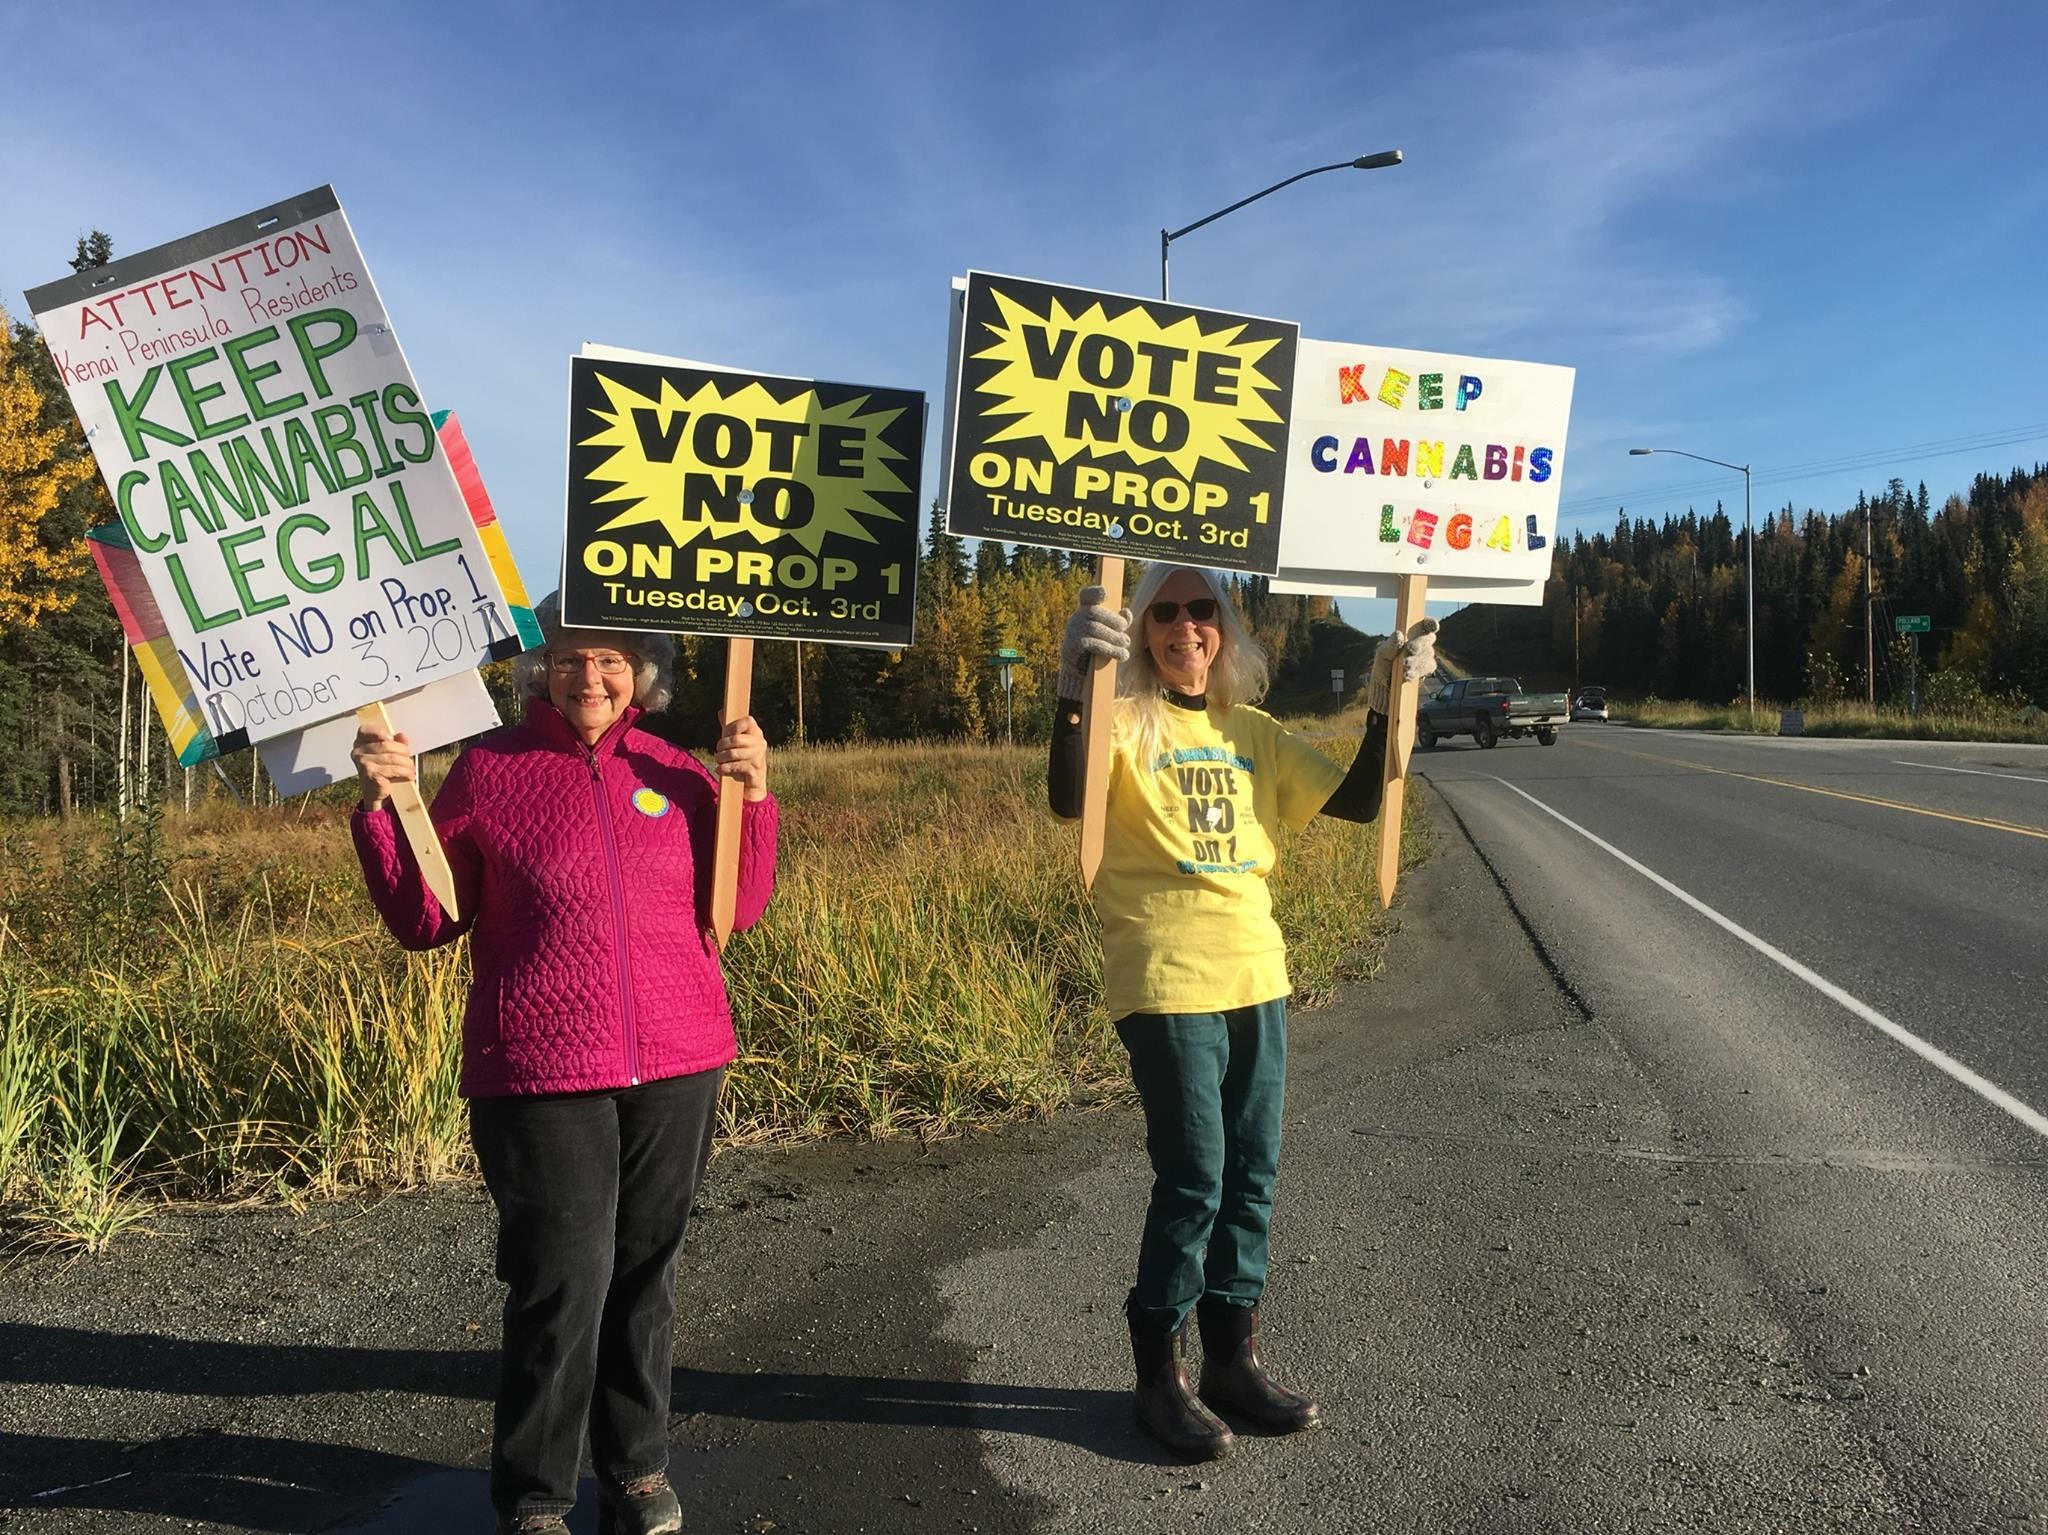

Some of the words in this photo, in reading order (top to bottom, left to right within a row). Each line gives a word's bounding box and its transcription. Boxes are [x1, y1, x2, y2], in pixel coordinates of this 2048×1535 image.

[80, 224, 331, 339] ATTENTION
[53, 345, 119, 387] Kenai
[119, 303, 232, 365] Peninsula
[240, 266, 358, 324] Residents
[103, 307, 358, 462] KEEP
[1021, 324, 1242, 407] VOTE
[1339, 363, 1483, 411] KEEP
[631, 407, 866, 479] VOTE
[1064, 390, 1191, 453] NO
[117, 382, 435, 554] CANNABIS
[969, 452, 1053, 494] ON
[1073, 465, 1229, 516] PROP
[1249, 492, 1270, 524] 1
[1311, 435, 1553, 483] CANNABIS
[682, 472, 815, 530] NO
[986, 494, 1120, 536] Tuesday
[1129, 514, 1188, 541] Oct.
[1200, 523, 1249, 549] 3rd
[1379, 504, 1546, 552] LEGAL
[164, 480, 462, 634] LEGAL
[583, 540, 673, 580] ON
[696, 548, 858, 592] PROP
[880, 563, 901, 595] 1
[178, 639, 261, 692] Vote
[268, 606, 334, 666] NO
[350, 608, 386, 641] on
[380, 577, 457, 629] Prop.
[458, 554, 487, 603] 1
[603, 582, 745, 618] Tuesday
[755, 593, 818, 618] Oct.
[830, 597, 881, 621] 3rd
[351, 640, 401, 687] 3,
[1177, 767, 1238, 796] VOTE
[1187, 797, 1235, 834] NO
[1193, 839, 1221, 863] on
[1226, 836, 1237, 862] 1
